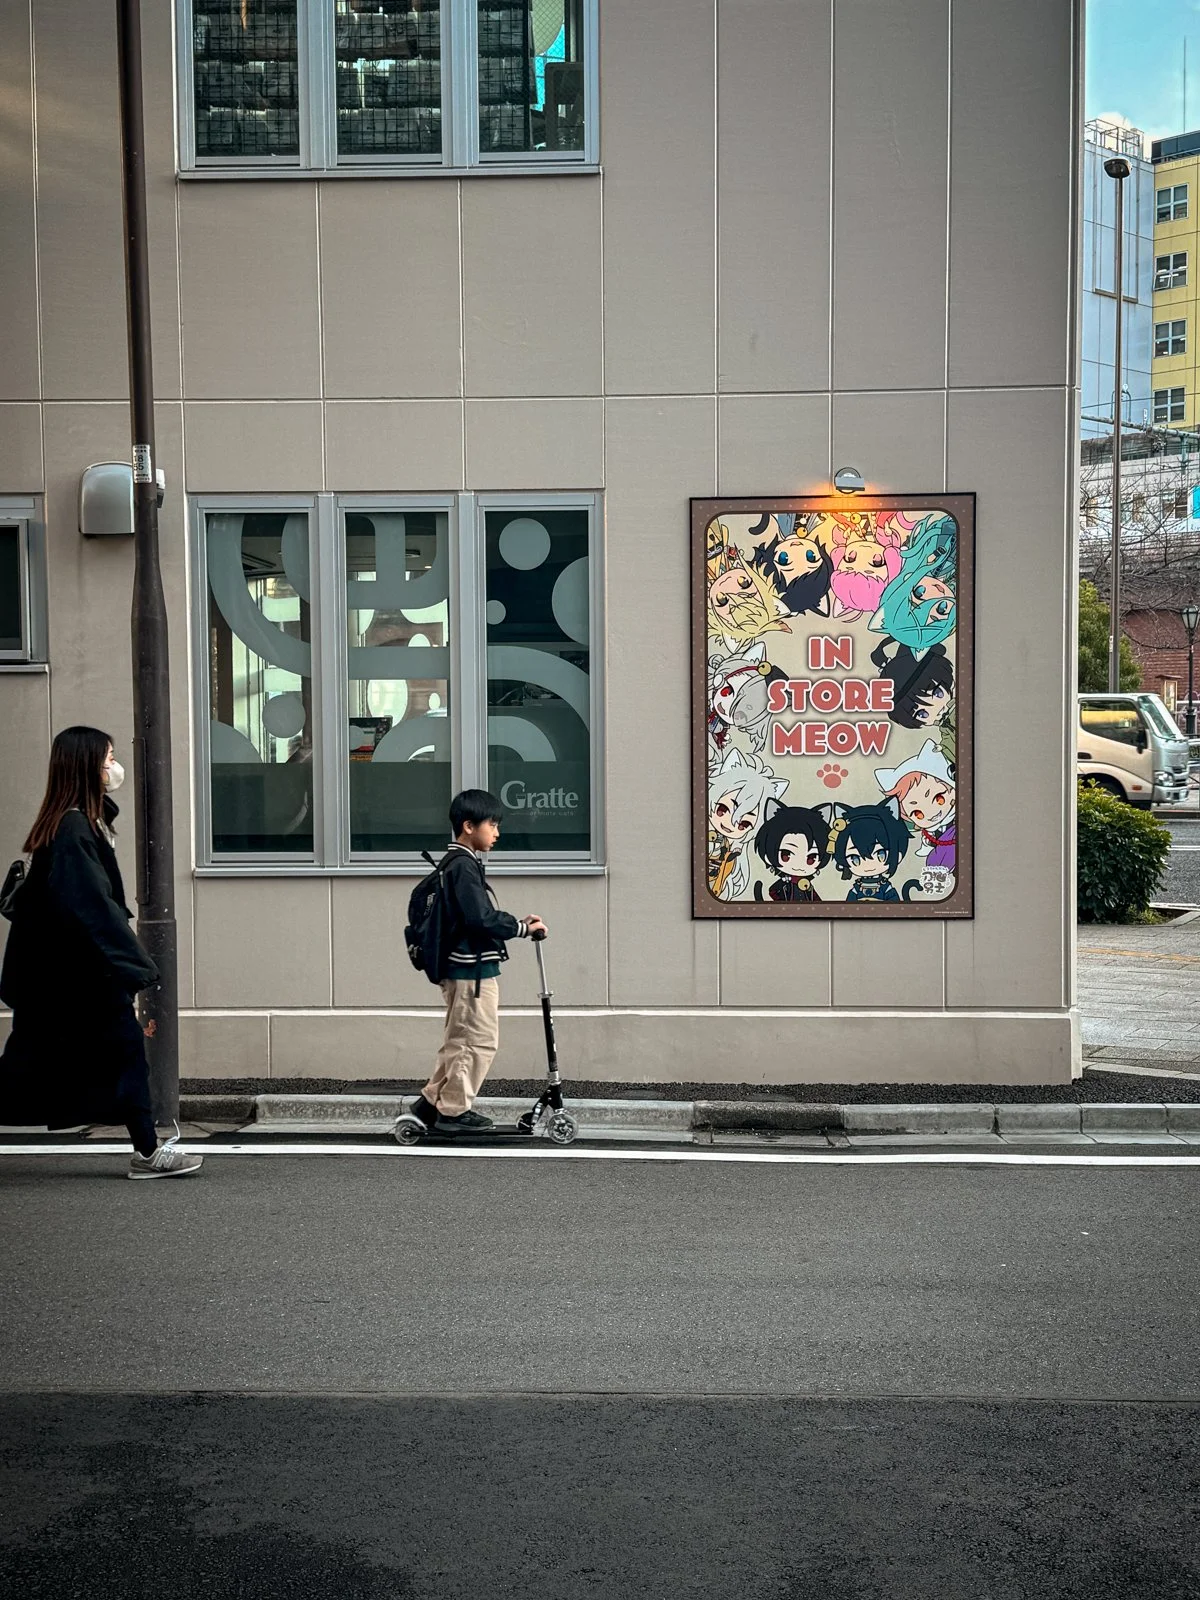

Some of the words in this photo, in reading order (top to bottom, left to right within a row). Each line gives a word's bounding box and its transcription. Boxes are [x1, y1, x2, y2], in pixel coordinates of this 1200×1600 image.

[808, 636, 853, 670] IN
[767, 679, 894, 713] STORE
[772, 721, 892, 756] MEOW
[500, 780, 579, 809] Gratte
[156, 1154, 174, 1168] N
